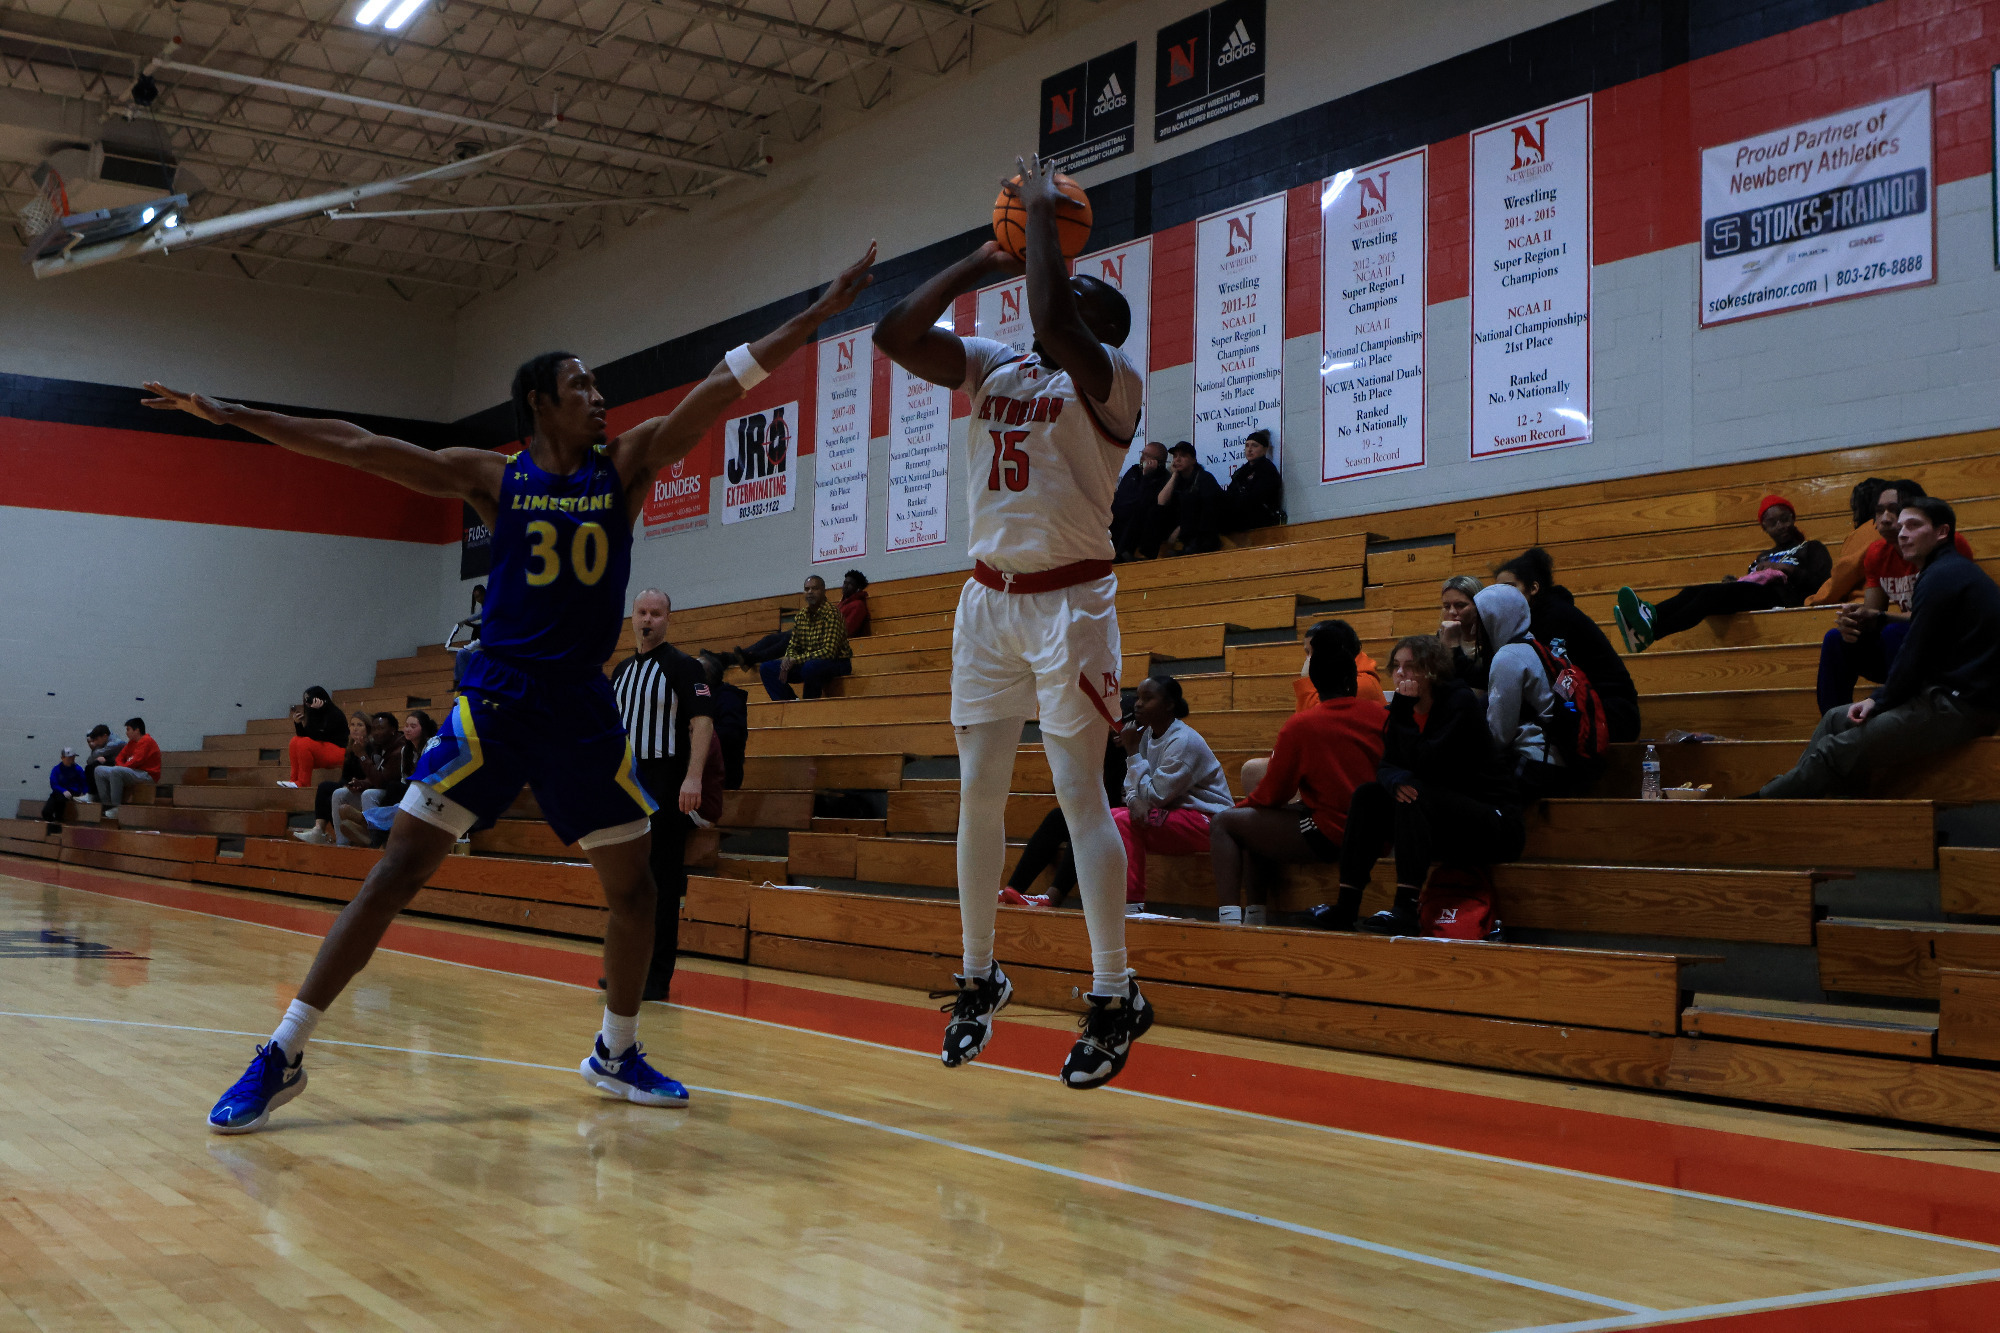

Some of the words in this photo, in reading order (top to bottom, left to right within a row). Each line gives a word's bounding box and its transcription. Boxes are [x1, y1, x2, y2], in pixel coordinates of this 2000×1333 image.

[1218, 42, 1256, 66] adidas
[1093, 94, 1127, 117] adidas
[1172, 121, 1188, 133] NCAA
[1188, 116, 1206, 125] SUPER
[1207, 106, 1228, 118] REGION
[1233, 93, 1259, 109] CHAMPS
[1176, 102, 1207, 120] NEWBERRY
[1207, 90, 1240, 108] WRESTLING
[1071, 147, 1094, 159] WOMEN'S
[1094, 134, 1126, 151] BASKETBALL
[1511, 117, 1549, 170] N
[1736, 135, 1790, 168] Proud
[1794, 121, 1861, 152] Partner
[1867, 108, 1888, 133] of
[1068, 153, 1101, 171] TOURNAMENT
[1102, 145, 1124, 158] CHAMPS
[1730, 160, 1812, 195] Newberry
[1818, 136, 1900, 173] Athletics
[1506, 162, 1554, 183] NEWBERRY
[1356, 171, 1390, 220] N
[1503, 188, 1557, 209] Wrestling
[1505, 214, 1525, 230] 2014
[1535, 207, 1555, 222] 2015
[1751, 174, 1918, 247] STOKES-TRAINOR
[1353, 214, 1395, 230] NEWBERRY
[1226, 212, 1256, 257] N
[1352, 231, 1397, 251] Wrestling
[1508, 233, 1540, 250] NCAA
[1544, 230, 1551, 240] II
[1849, 234, 1885, 248] GMC
[1220, 254, 1257, 271] NEWBERRY
[1353, 258, 1369, 272] 2012
[1378, 251, 1395, 265] 2013
[1494, 257, 1521, 271] Super
[1525, 246, 1559, 264] Region
[1563, 243, 1567, 254] I
[1356, 269, 1382, 283] NCAA
[1385, 266, 1391, 276] II
[1502, 265, 1559, 287] Champions
[1709, 278, 1817, 312] stokestrainor.com
[1837, 254, 1922, 285] 803-276-8888
[1219, 277, 1260, 295] Wrestling
[1343, 286, 1370, 300] Super
[1369, 278, 1399, 293] Region
[1401, 274, 1404, 285] I
[1221, 293, 1256, 315] 2011-12
[1349, 295, 1397, 314] Champions
[1508, 303, 1540, 319] NCAA
[1544, 299, 1551, 310] II
[1222, 315, 1247, 330] NCAA
[1249, 312, 1255, 322] II
[1355, 320, 1382, 335] NCAA
[1384, 318, 1390, 329] II
[1475, 326, 1513, 344] National
[1515, 312, 1587, 335] Championships
[1211, 336, 1232, 348] Super
[1234, 328, 1261, 342] Region
[1263, 325, 1266, 334] I
[1326, 344, 1358, 360] National
[1361, 330, 1423, 352] Championships
[1505, 342, 1522, 354] 21st
[1526, 336, 1553, 349] Place
[1217, 344, 1259, 360] Champions
[1353, 358, 1367, 369] 6th
[1369, 354, 1392, 365] Place
[1221, 359, 1245, 373] NCAA
[1248, 357, 1255, 366] II
[1196, 381, 1225, 393] National
[1227, 368, 1281, 386] Championships
[1325, 380, 1354, 395] NCWA
[1357, 370, 1394, 388] National
[1397, 365, 1422, 380] Duals
[1510, 369, 1547, 387] Ranked
[1221, 391, 1232, 401] 5th
[1235, 387, 1255, 399] Place
[1353, 391, 1367, 403] 5th
[1369, 387, 1392, 400] Place
[1489, 393, 1506, 404] No.
[1509, 390, 1514, 401] 9
[1517, 380, 1570, 400] Nationally
[1196, 410, 1222, 423] NWCA
[1224, 402, 1256, 418] National
[1259, 399, 1281, 411] Duals
[1357, 404, 1388, 420] Ranked
[1517, 414, 1527, 427] 12
[1537, 412, 1542, 424] 2
[1217, 416, 1258, 432] Runner-Up
[1356, 424, 1360, 434] 4
[1362, 415, 1407, 433] Nationally
[1223, 436, 1246, 448] Ranke
[1378, 436, 1383, 447] 2
[1494, 432, 1526, 447] Season
[1530, 424, 1566, 441] Record
[988, 430, 1031, 492] 15
[1206, 455, 1220, 465] No.
[1222, 452, 1227, 461] 2
[1345, 453, 1370, 467] Season
[1373, 448, 1399, 463] Record
[654, 475, 700, 502] FOUNDERS
[726, 476, 786, 507] EXTERMINATING
[512, 493, 613, 512] LIMESTONE
[739, 500, 779, 519] 803-532-1122
[895, 534, 914, 546] Season
[916, 530, 938, 542] Record
[525, 520, 608, 586] 30
